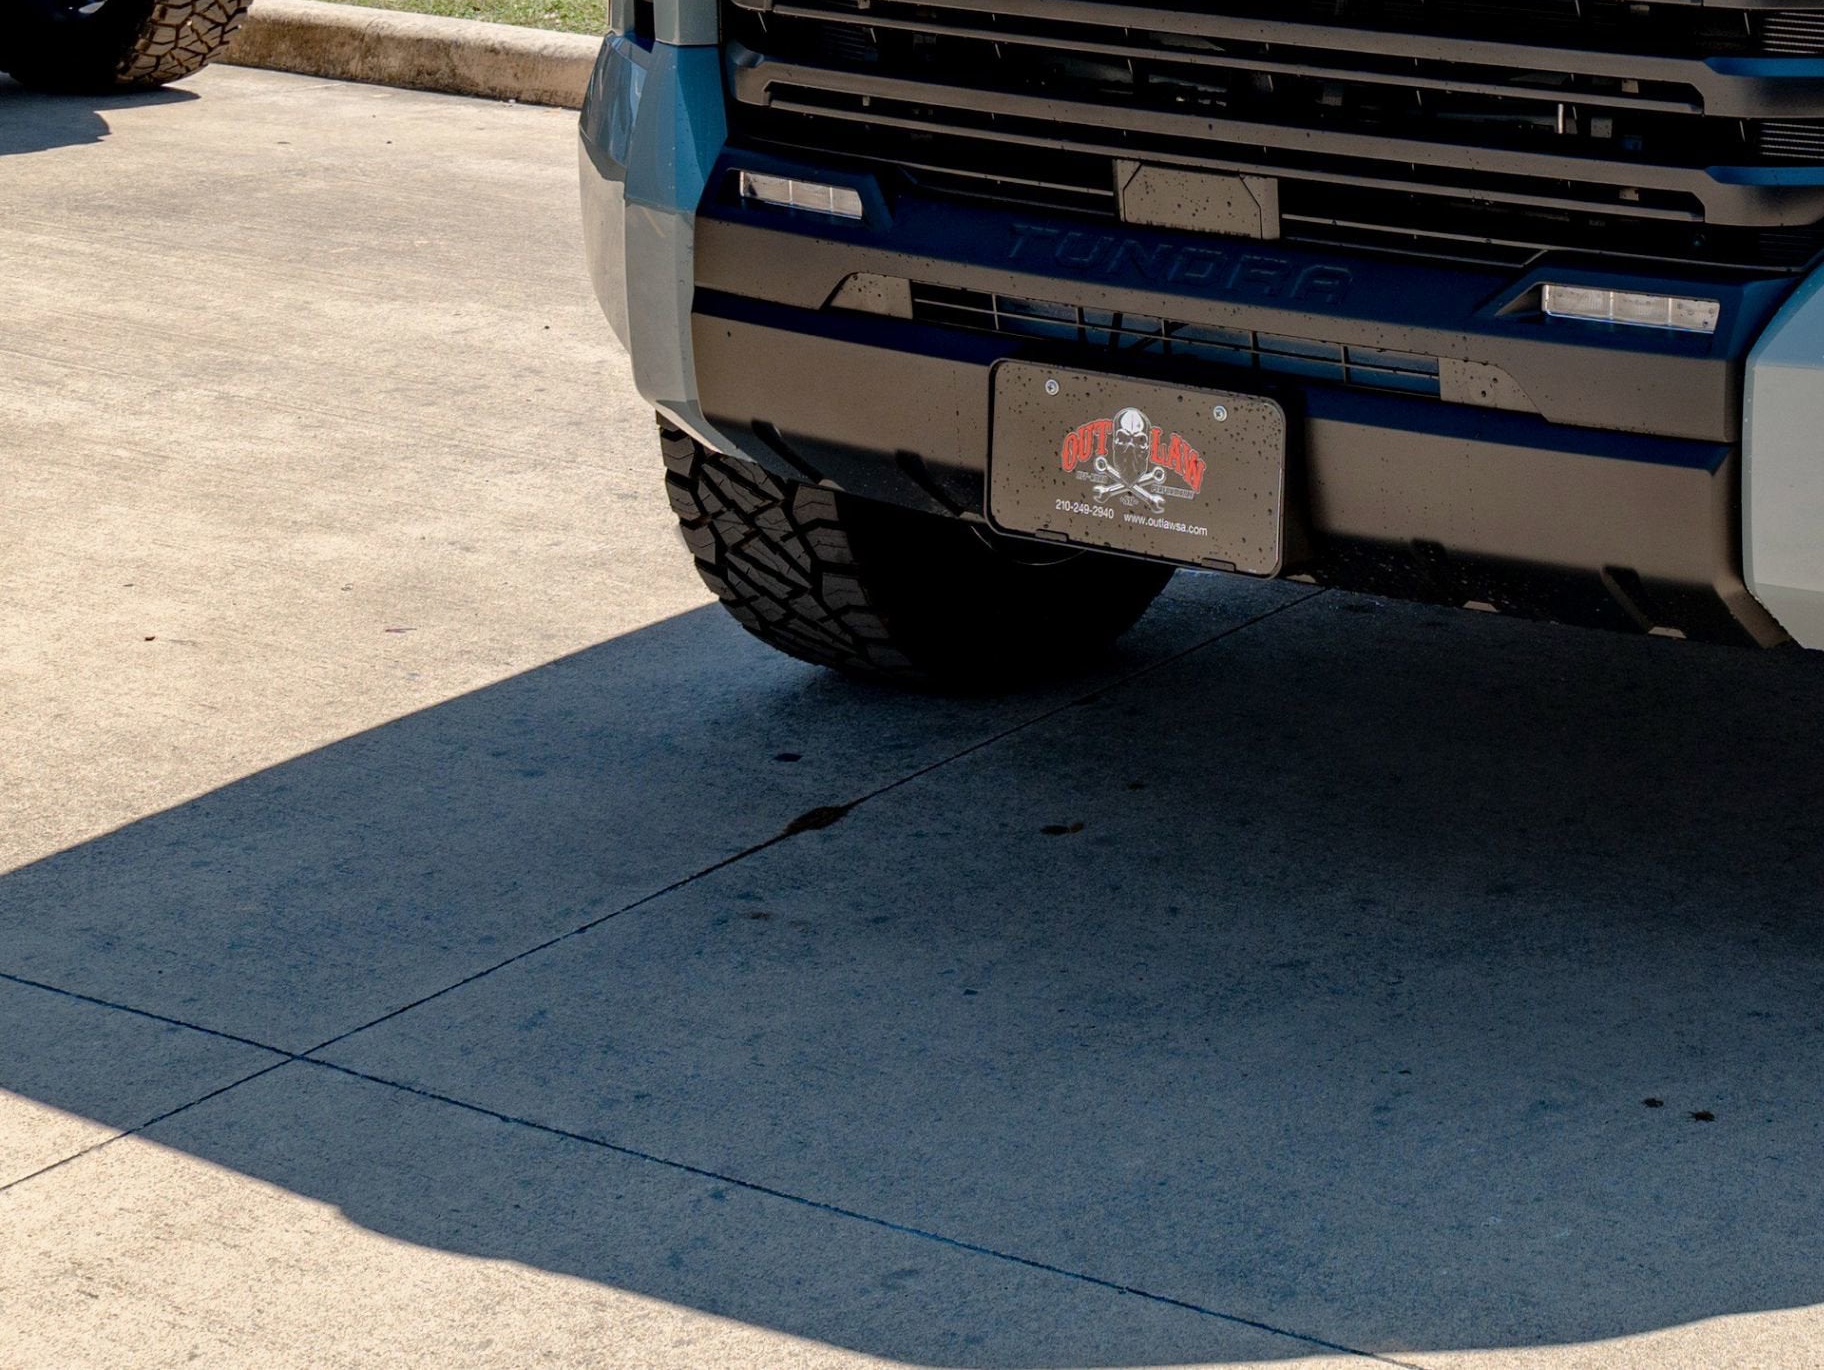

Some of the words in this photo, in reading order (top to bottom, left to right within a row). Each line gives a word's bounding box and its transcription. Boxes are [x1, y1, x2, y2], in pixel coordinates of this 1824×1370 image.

[1009, 223, 1353, 306] TUNDRA
[1055, 499, 1115, 519] 210-249-2940
[1123, 513, 1208, 536] www.outlawsa.com
